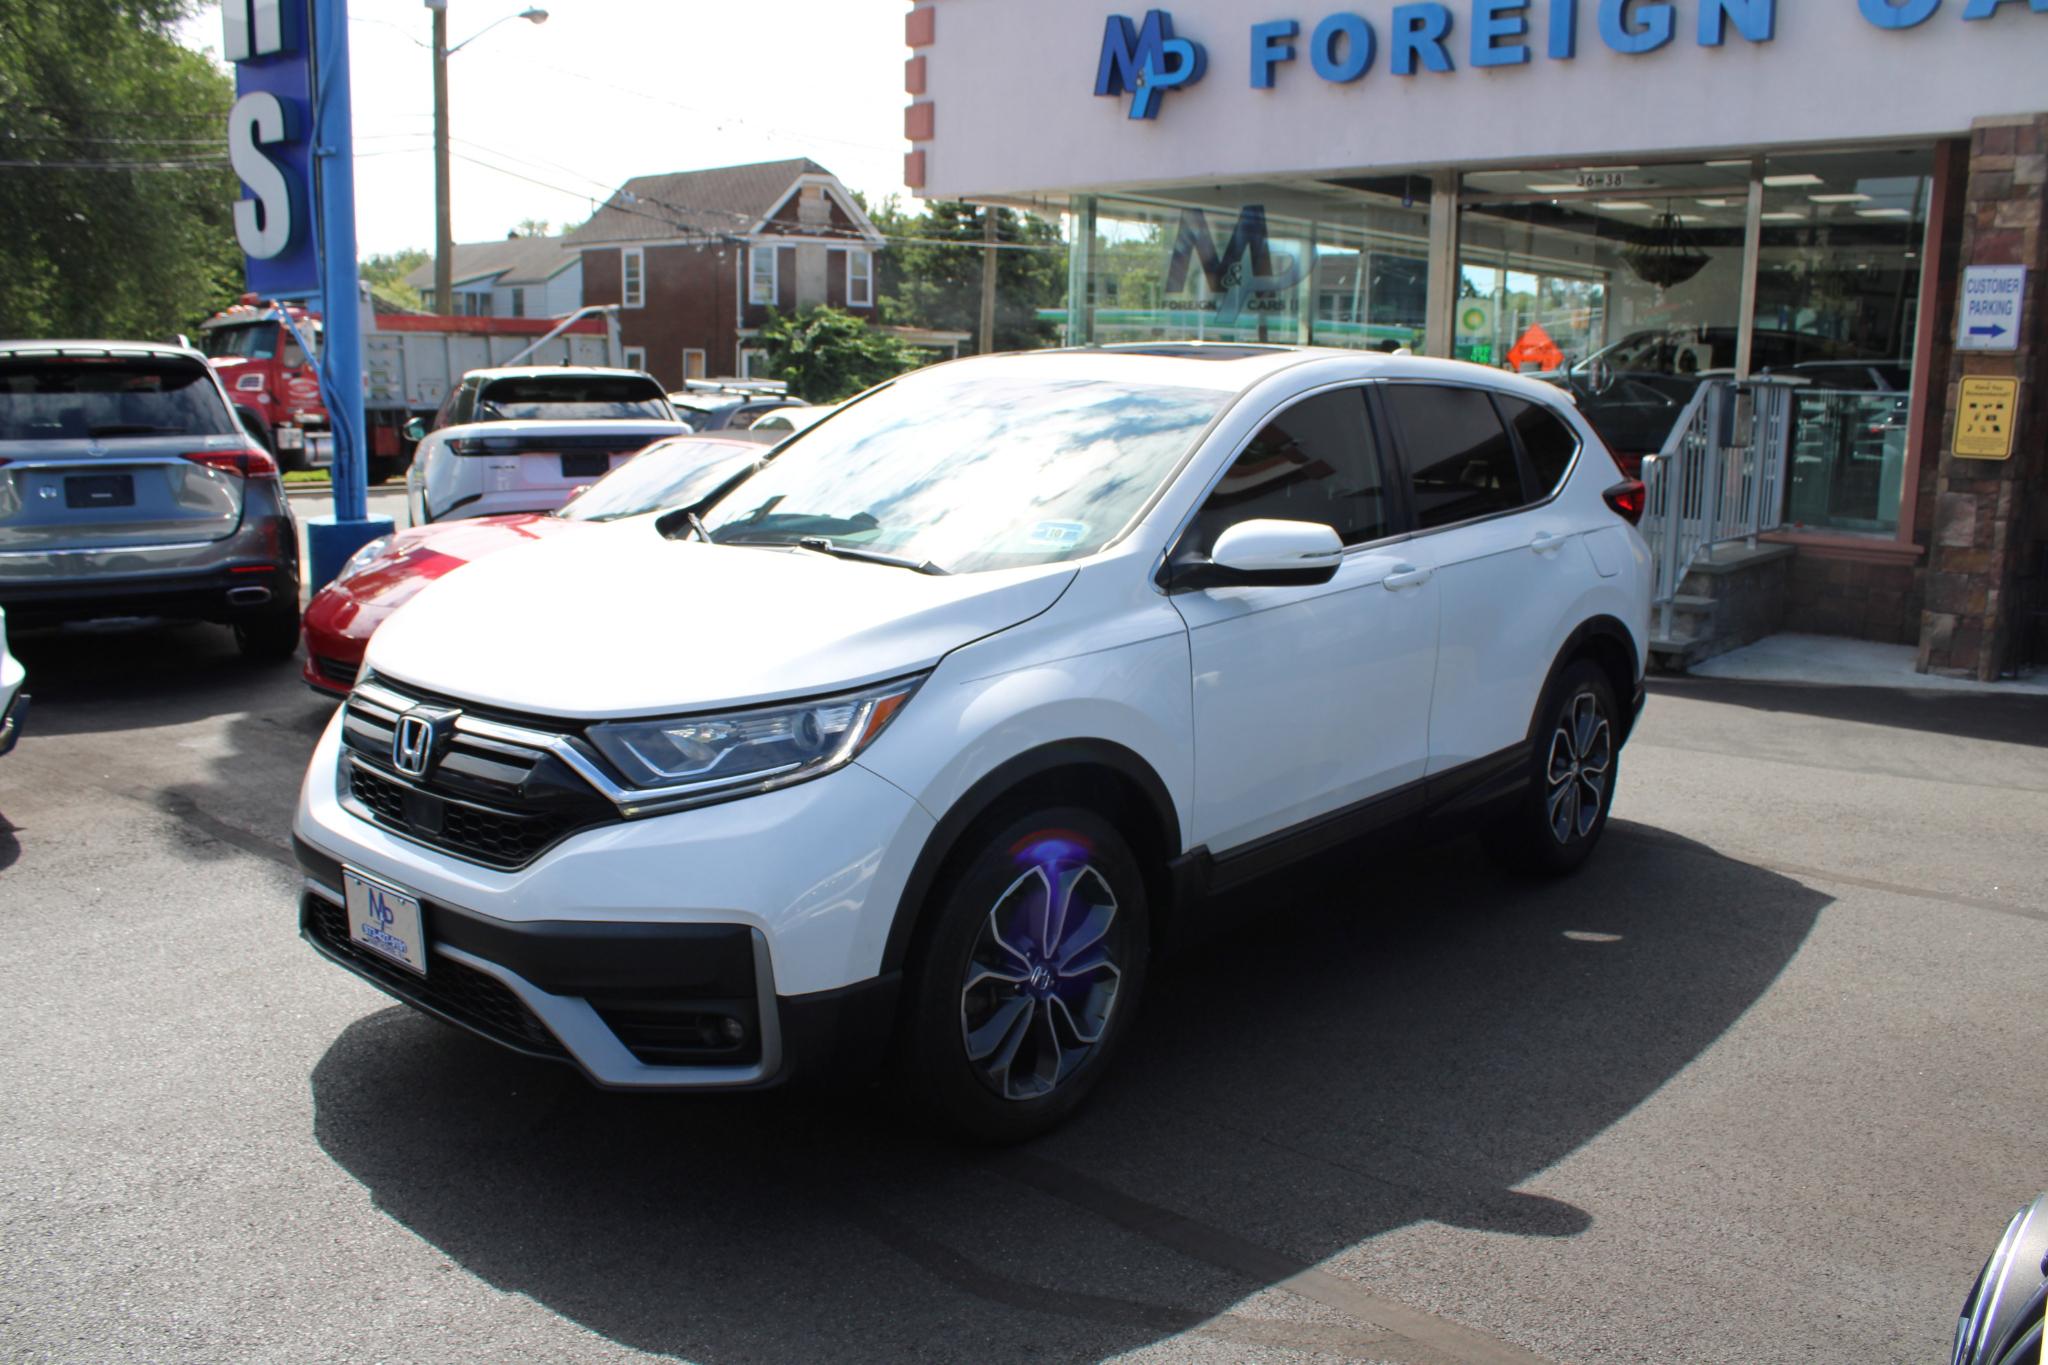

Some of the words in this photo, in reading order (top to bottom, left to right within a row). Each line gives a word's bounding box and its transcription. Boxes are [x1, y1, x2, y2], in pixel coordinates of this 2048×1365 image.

[1250, 0, 1775, 89] FOREIGN
[1967, 278, 2019, 293] CUSTOMER
[1161, 300, 1216, 311] FOREIGN
[1247, 299, 1285, 311] CARS
[1968, 300, 2012, 315] PARKING
